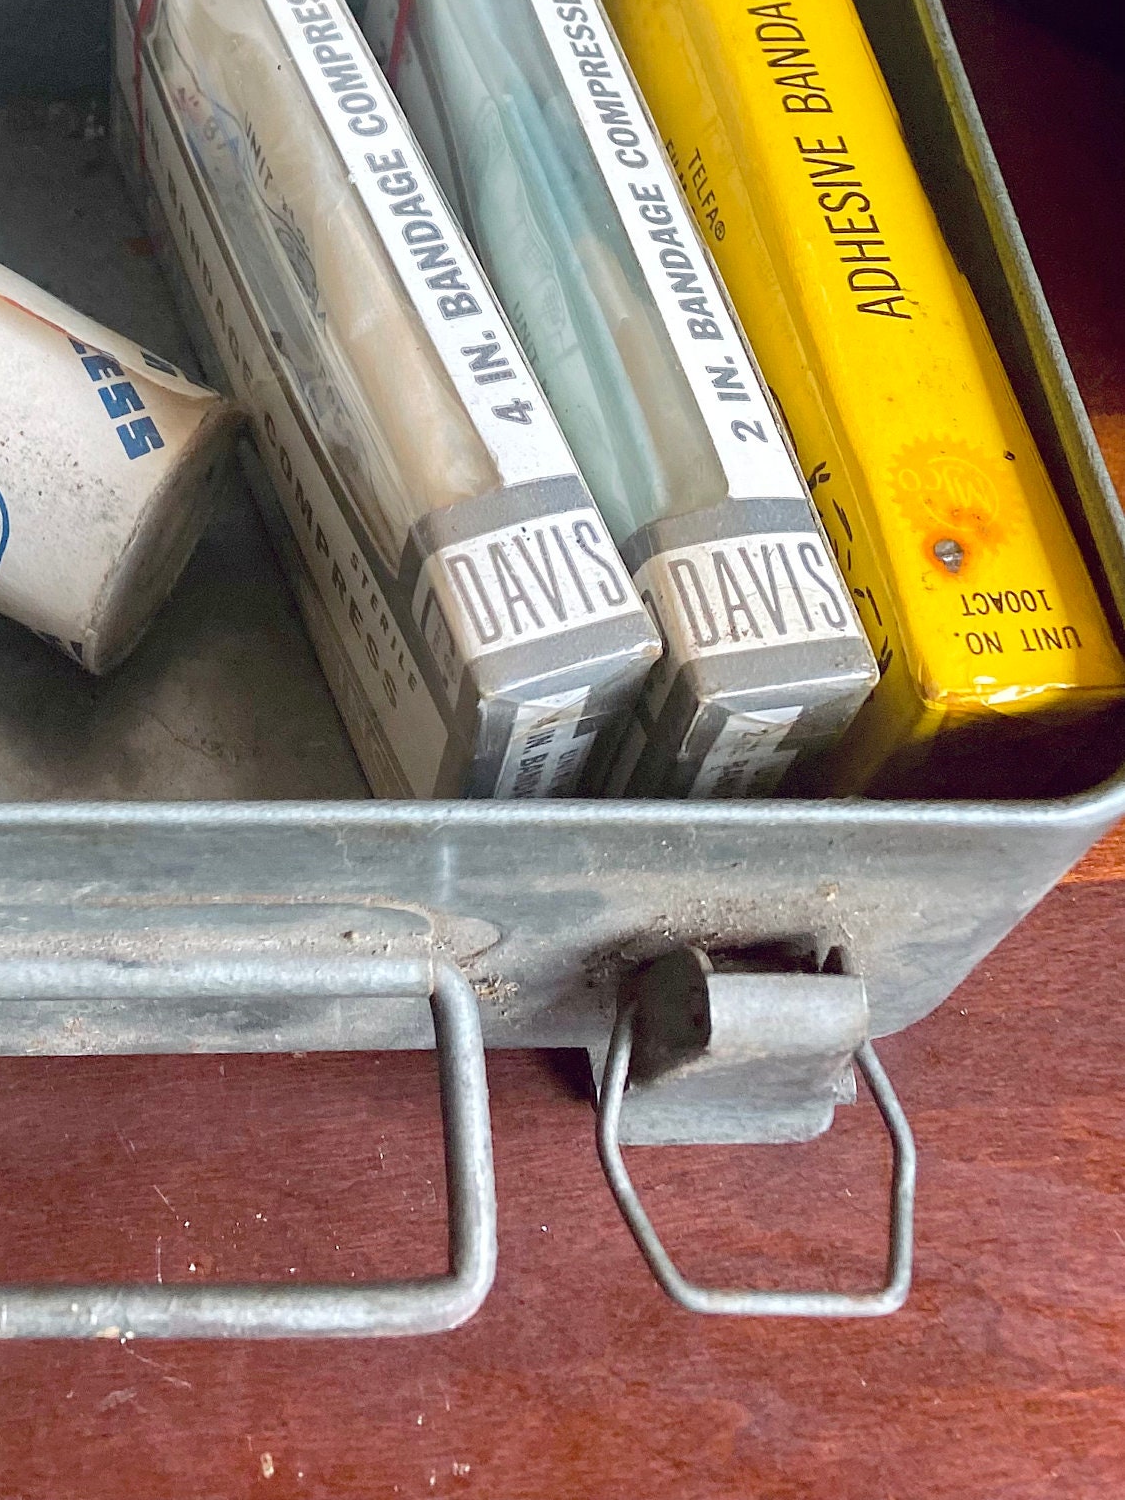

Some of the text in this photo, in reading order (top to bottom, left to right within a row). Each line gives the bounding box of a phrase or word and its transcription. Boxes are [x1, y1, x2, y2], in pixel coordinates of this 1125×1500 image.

[364, 148, 483, 321] BANDAGE
[628, 182, 724, 341] BANDAGE
[794, 135, 913, 320] ADHESIVE
[460, 330, 516, 386] IN.
[705, 355, 752, 403] IN.
[491, 398, 534, 426] 4
[731, 419, 769, 443] 2
[264, 410, 397, 709] COMPRESS
[444, 519, 628, 645] DAVIS
[668, 541, 848, 648] DAVIS
[961, 589, 1053, 617] 100ACT
[349, 551, 418, 693] STERILE
[953, 625, 1082, 656] UNIT NO.
